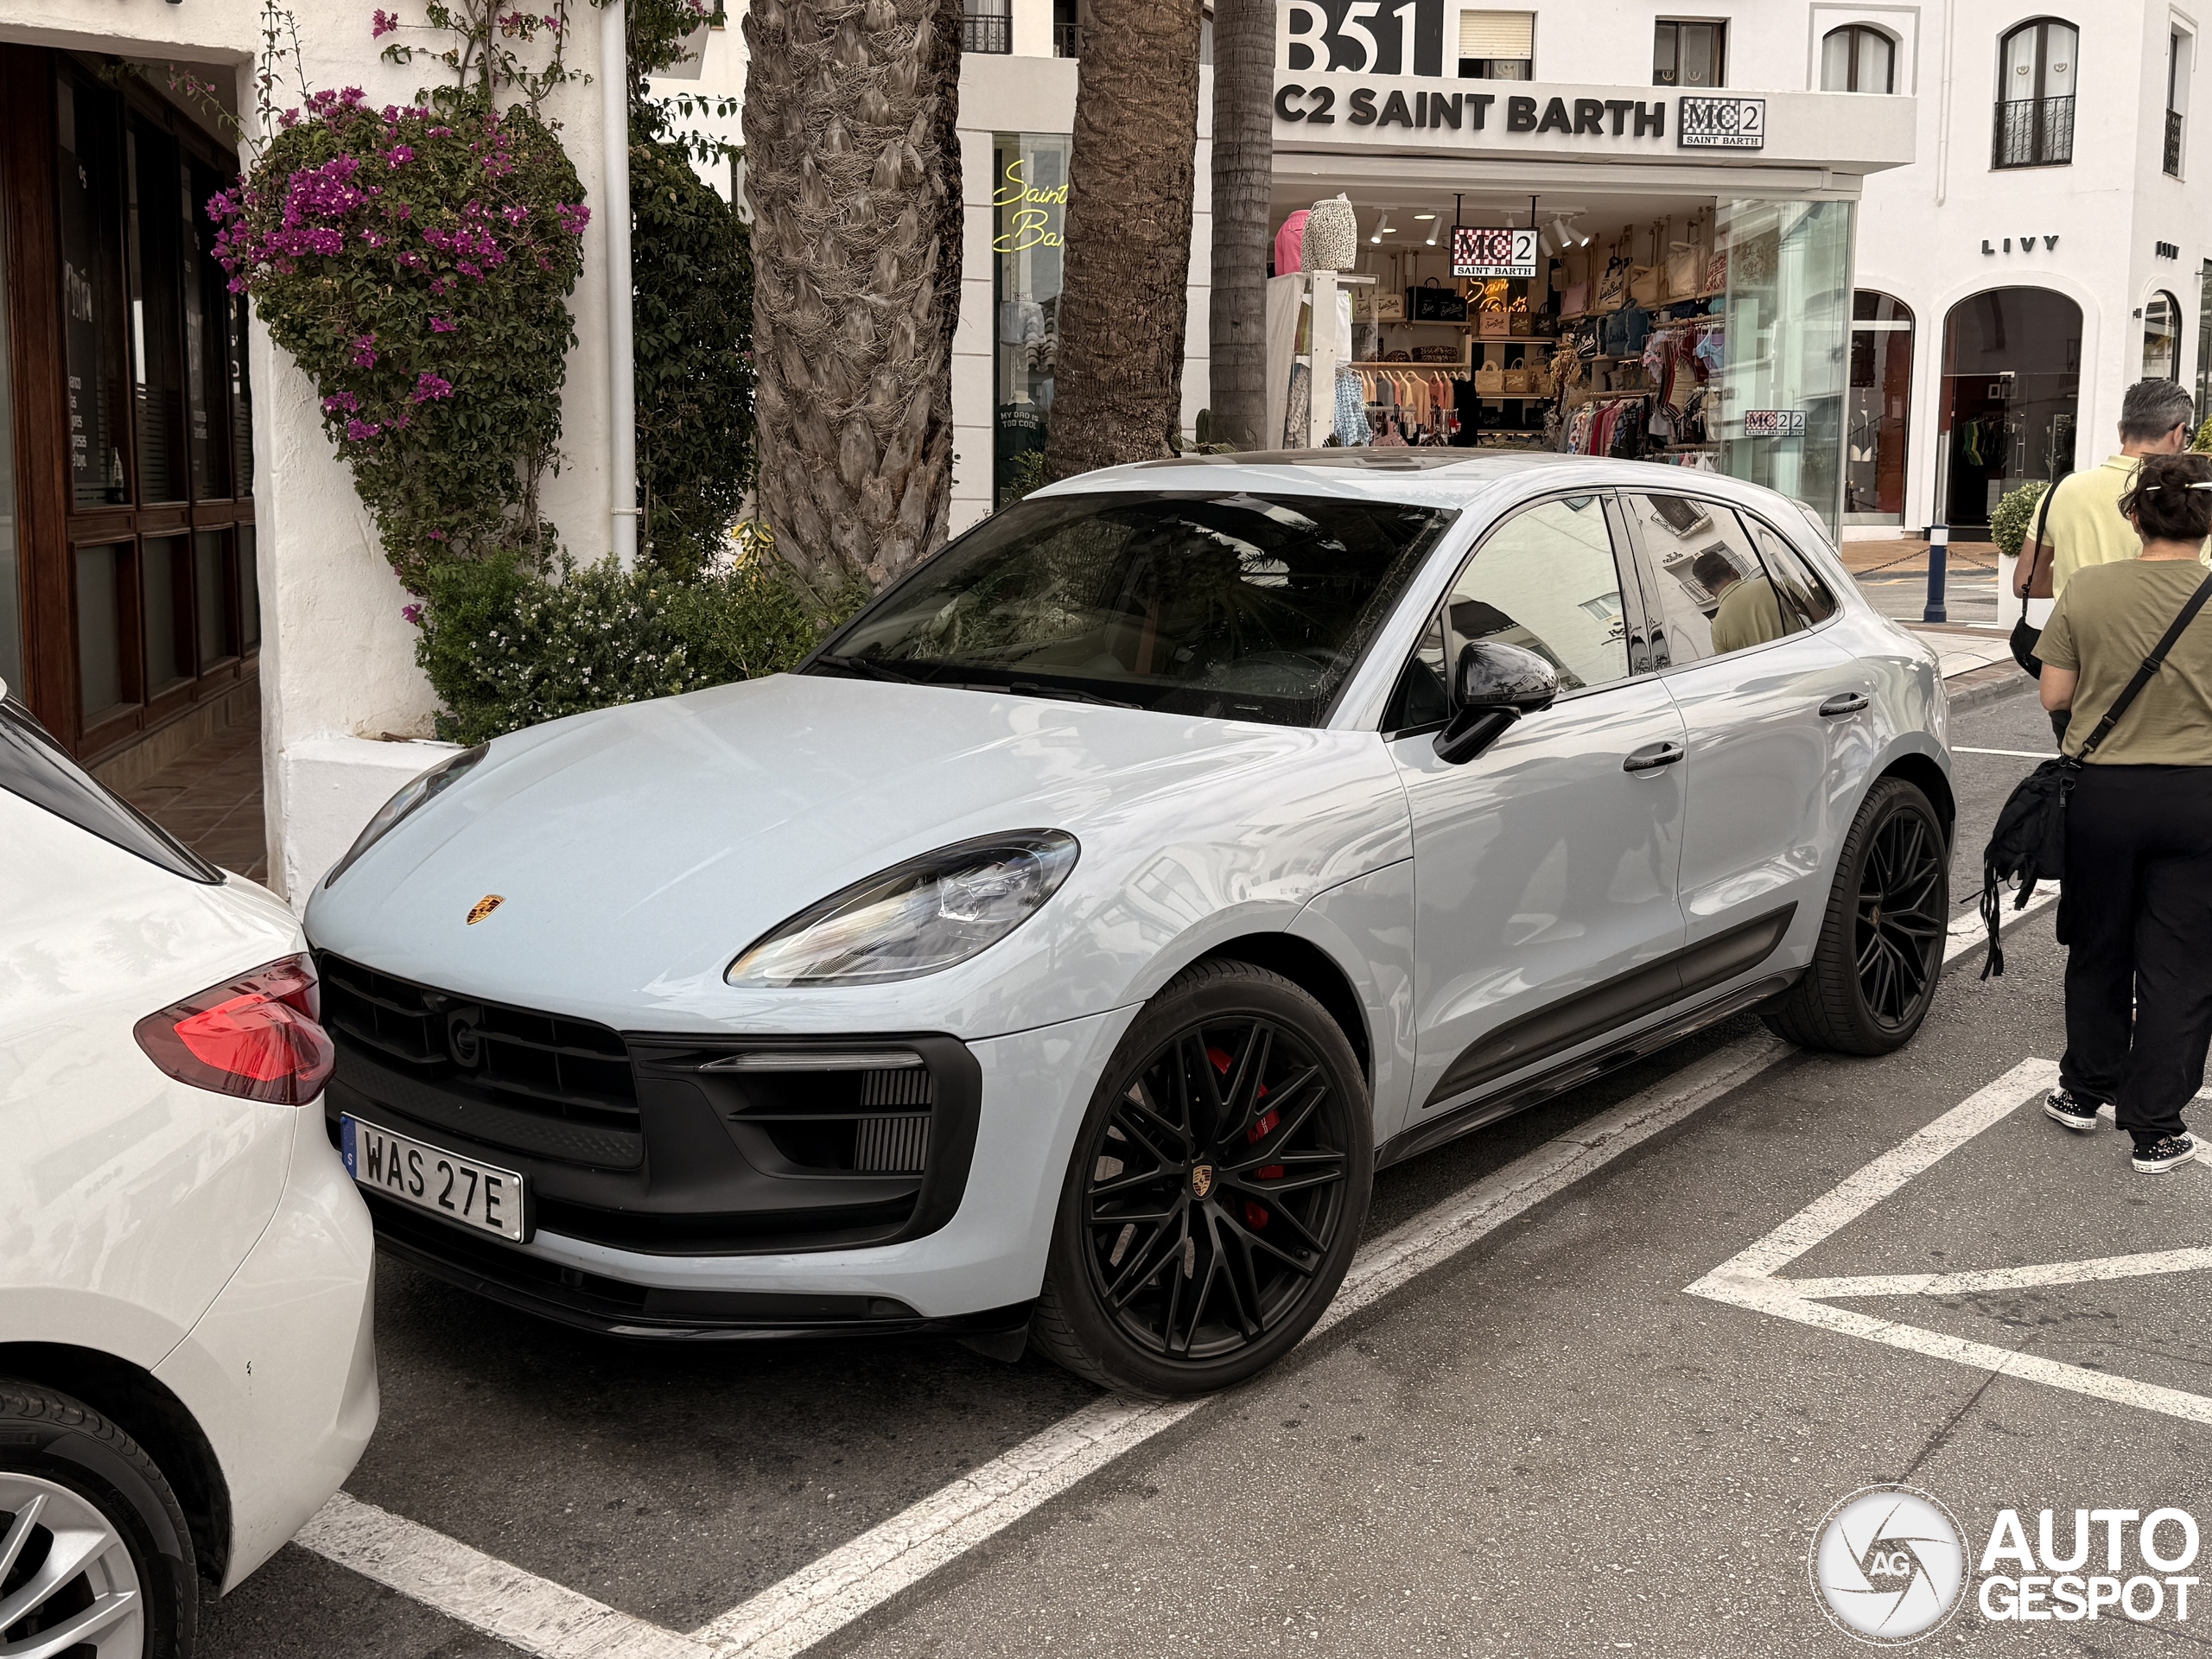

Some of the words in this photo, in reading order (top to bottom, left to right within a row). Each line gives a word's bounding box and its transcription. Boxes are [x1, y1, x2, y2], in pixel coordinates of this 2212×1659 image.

[1274, 0, 1415, 76] B51
[1274, 84, 1335, 124] C2
[1347, 88, 1496, 130] SAINT
[1507, 95, 1665, 137] BARTH
[993, 159, 1069, 207] Saint
[1981, 235, 2060, 254] LIVY
[1002, 420, 1017, 429] TOO
[1018, 420, 1037, 429] COOL
[346, 1153, 353, 1166] S
[365, 1130, 425, 1198] WAS
[437, 1159, 504, 1229] 27E
